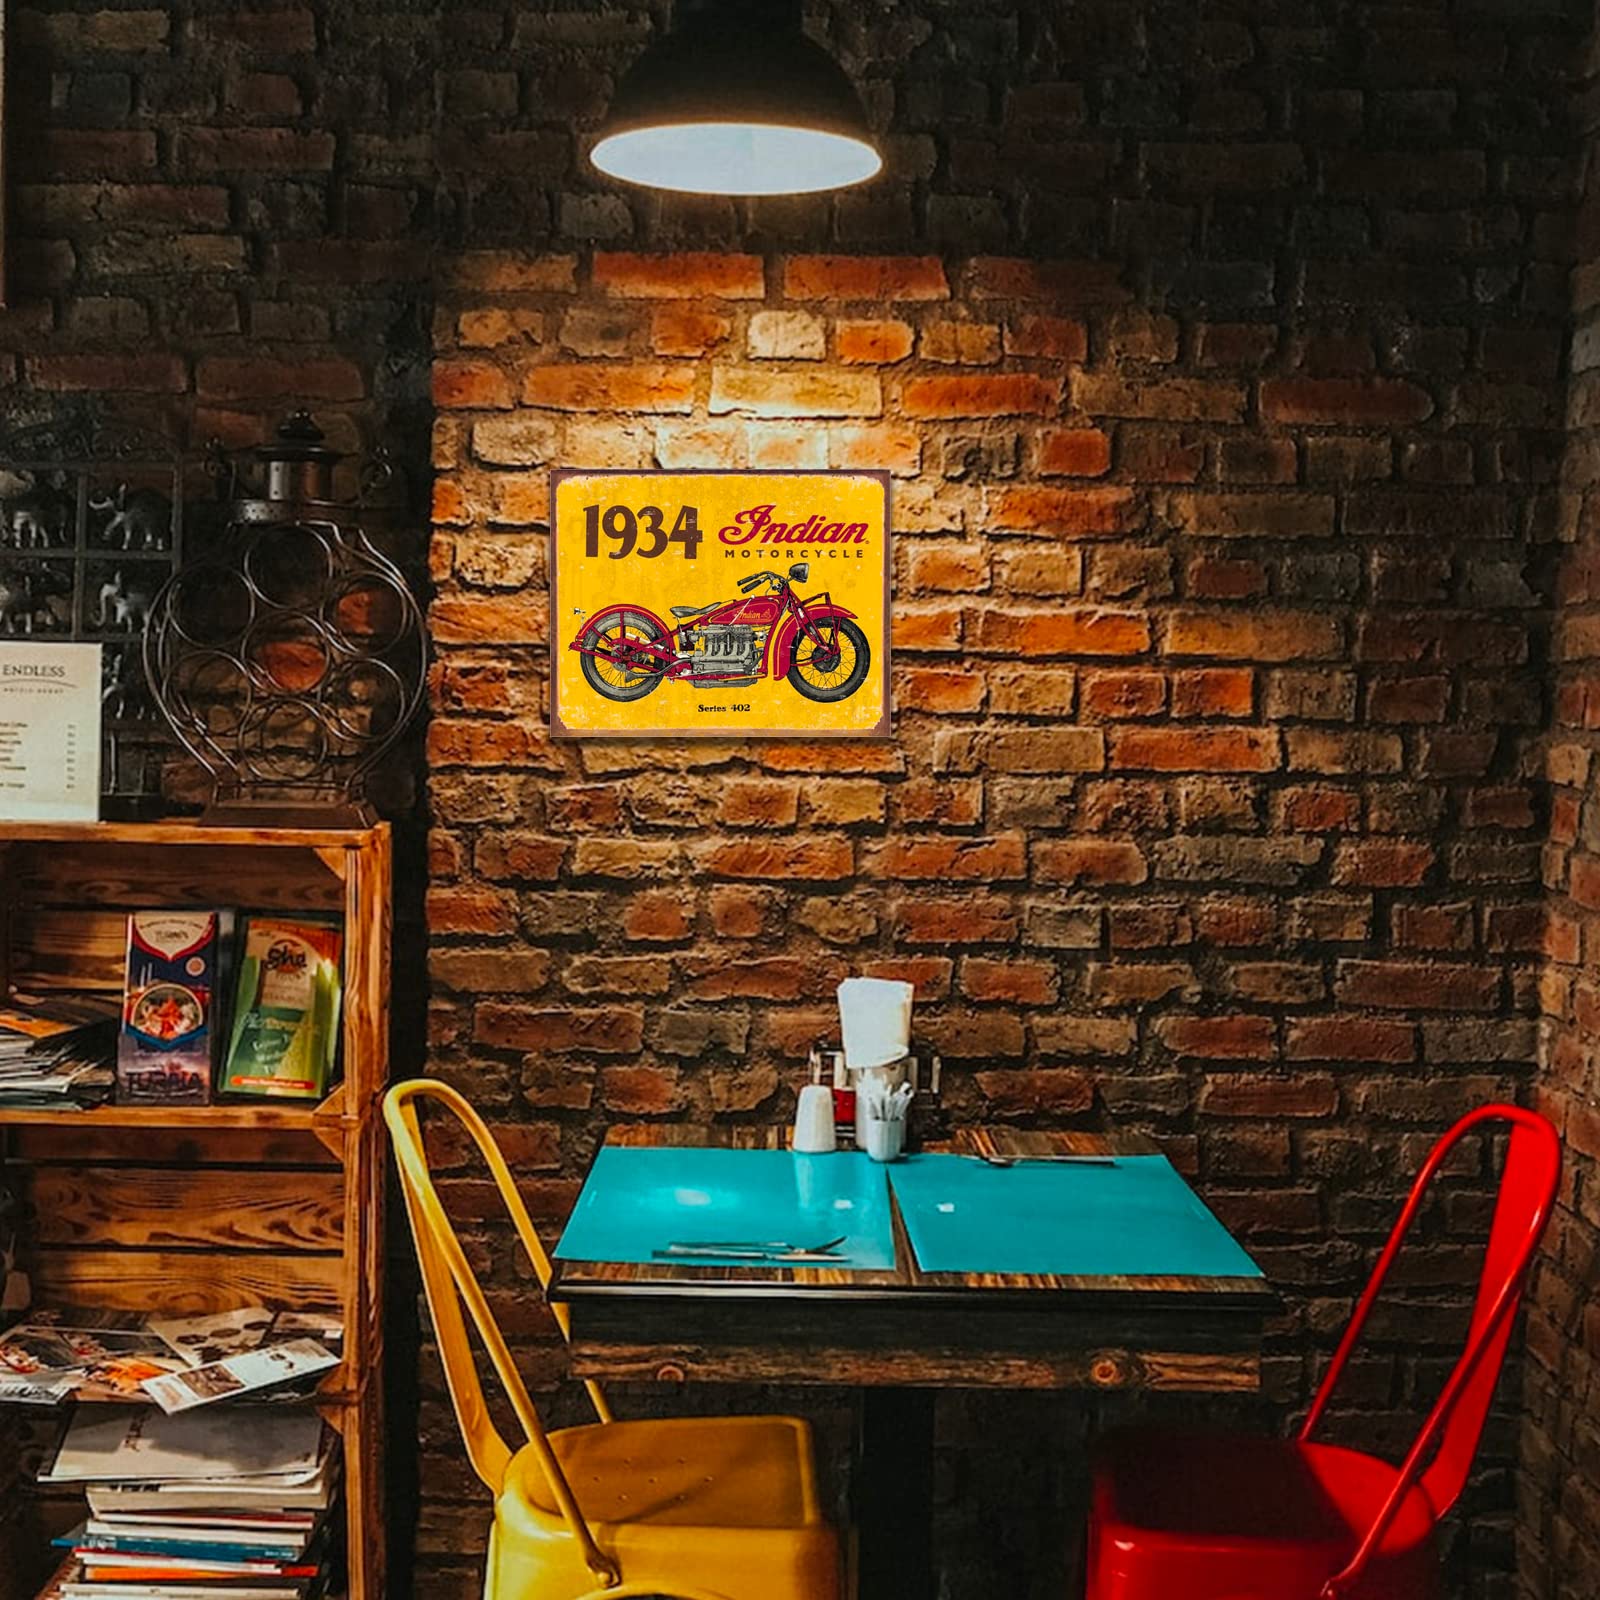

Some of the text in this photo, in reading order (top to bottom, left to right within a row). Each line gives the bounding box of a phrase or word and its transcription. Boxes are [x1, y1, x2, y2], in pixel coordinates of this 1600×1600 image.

[718, 504, 869, 545] Indian
[583, 504, 703, 560] 1934
[724, 549, 863, 558] MOTORCYCLE
[3, 664, 66, 677] ENDLESS
[698, 703, 751, 712] Series 402
